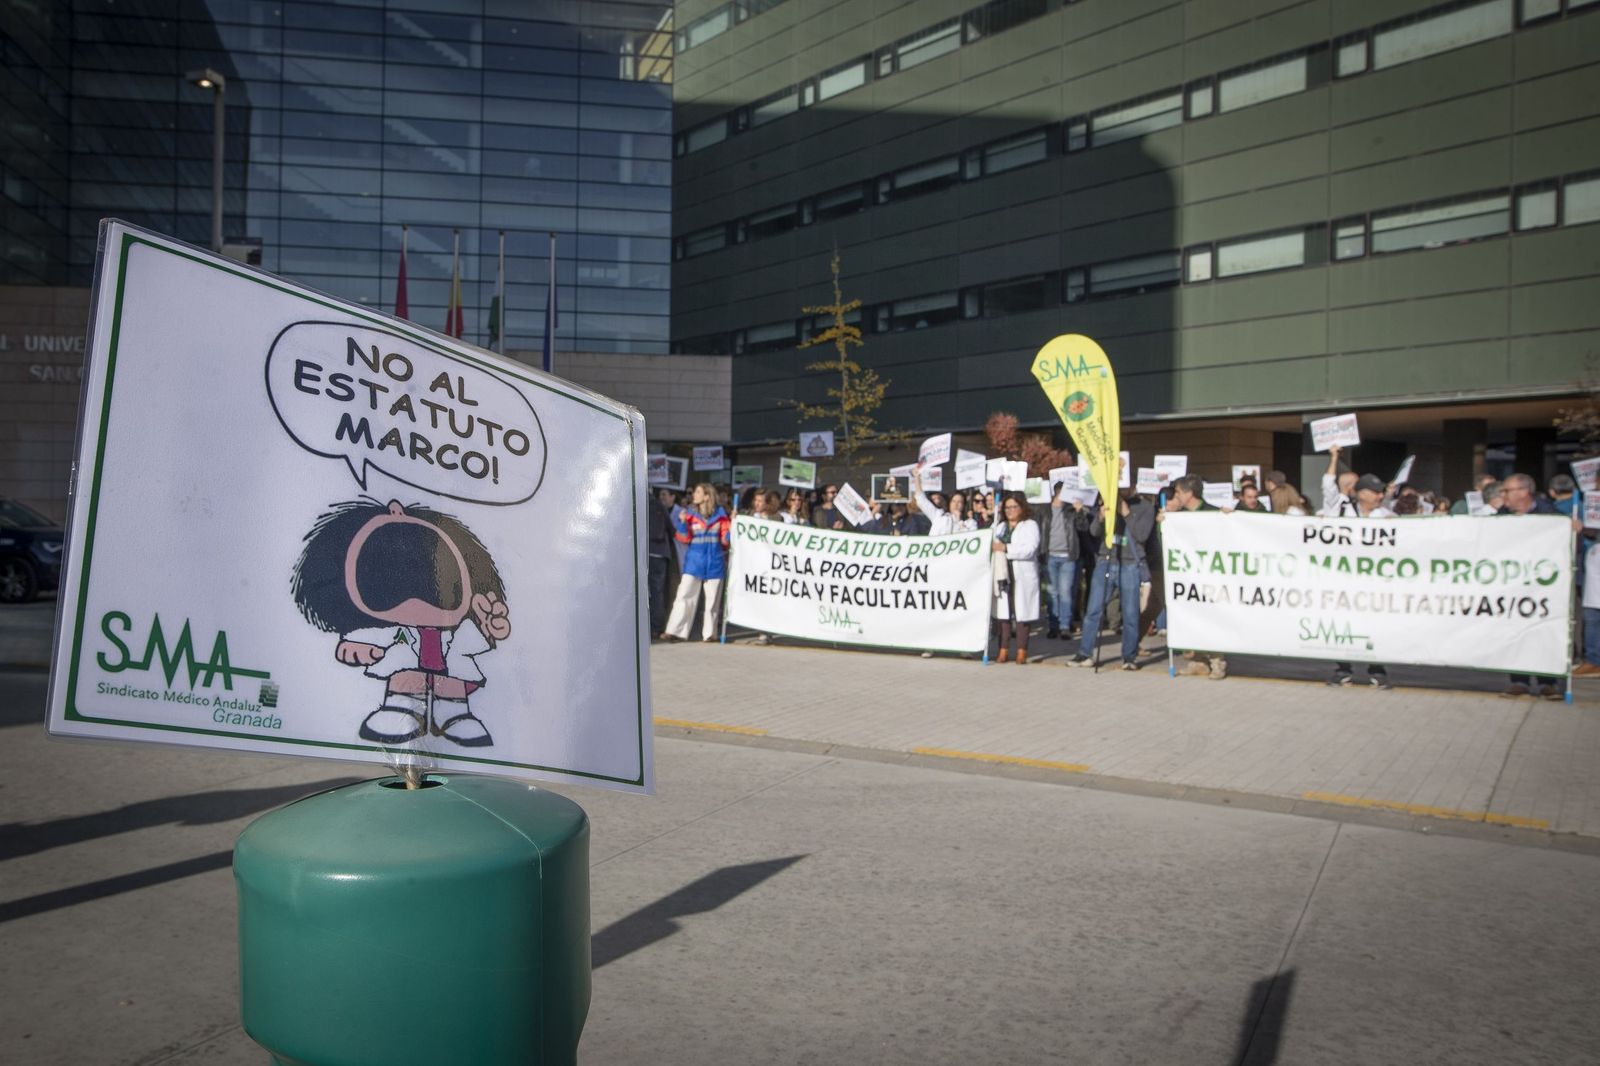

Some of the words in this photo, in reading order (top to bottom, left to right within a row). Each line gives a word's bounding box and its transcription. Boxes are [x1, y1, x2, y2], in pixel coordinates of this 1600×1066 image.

[346, 336, 414, 382] NO
[429, 371, 478, 406] AL
[1039, 355, 1103, 382] SMA
[294, 359, 530, 456] ESTATUTO
[335, 412, 499, 484] MARCO!
[736, 522, 768, 544] POR
[773, 529, 802, 548] UN
[805, 535, 901, 559] ESTATUTO
[906, 536, 981, 559] PROPIO
[1302, 525, 1353, 546] POR
[1361, 527, 1396, 546] UN
[771, 552, 791, 572] DE
[794, 556, 814, 576] LA
[820, 559, 929, 583] PROFESIÓN
[1167, 548, 1297, 577] ESTATUTO
[1309, 554, 1420, 579] MARCO
[1429, 558, 1560, 586] PROPIO
[814, 583, 825, 601] Y
[830, 585, 968, 610] FACULTATIVA
[1173, 582, 1230, 604] PARA
[1239, 586, 1314, 608] LAS/OS
[1321, 590, 1549, 618] FACULTATIVAS/OS
[818, 605, 861, 629] SMA
[1299, 617, 1369, 645] SMA
[96, 611, 270, 691] SMA
[97, 682, 159, 702] Sindicato
[163, 690, 210, 708] Médico
[212, 696, 262, 713] Andaluz
[212, 708, 282, 730] Granada
